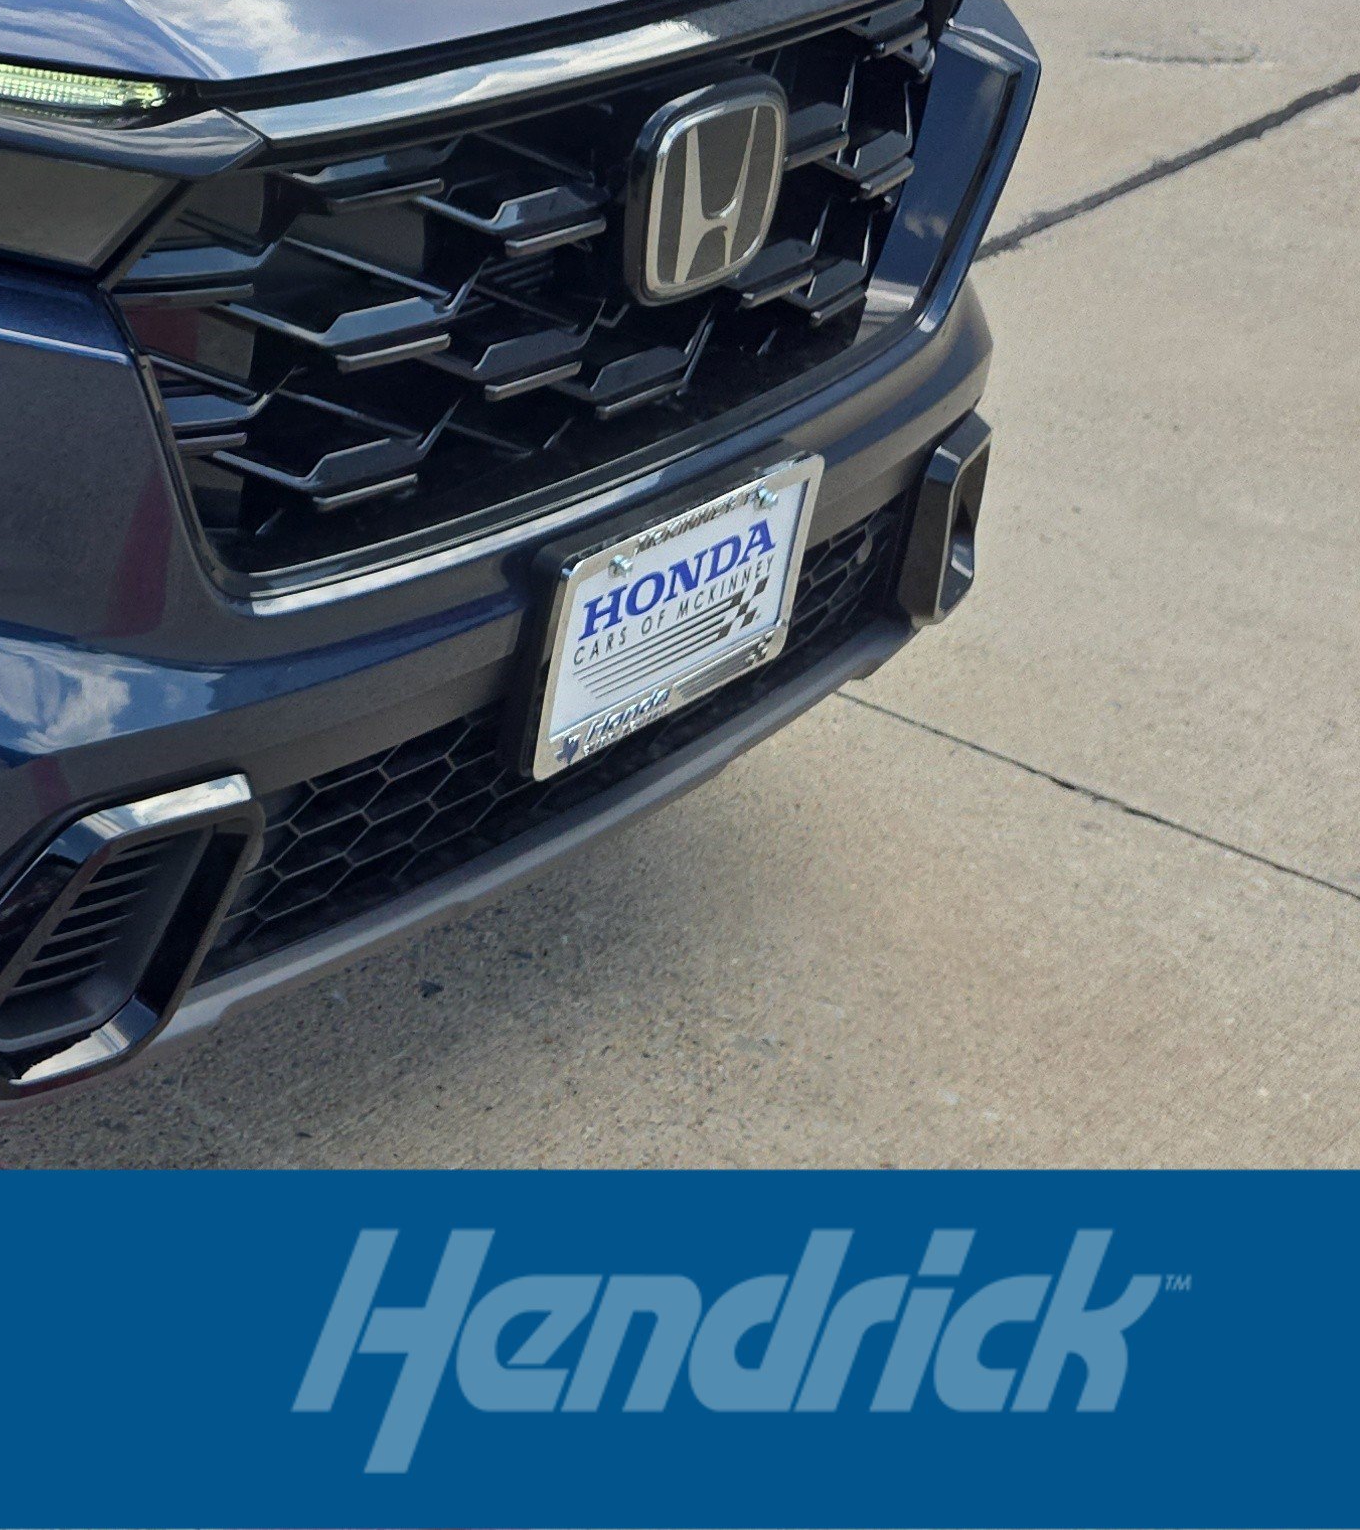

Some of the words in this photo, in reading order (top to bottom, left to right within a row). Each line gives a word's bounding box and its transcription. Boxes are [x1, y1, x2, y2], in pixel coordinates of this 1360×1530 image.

[573, 626, 628, 666] CARS
[641, 609, 666, 636] OF
[676, 554, 775, 621] MCKINNEY
[578, 518, 776, 641] HONDA
